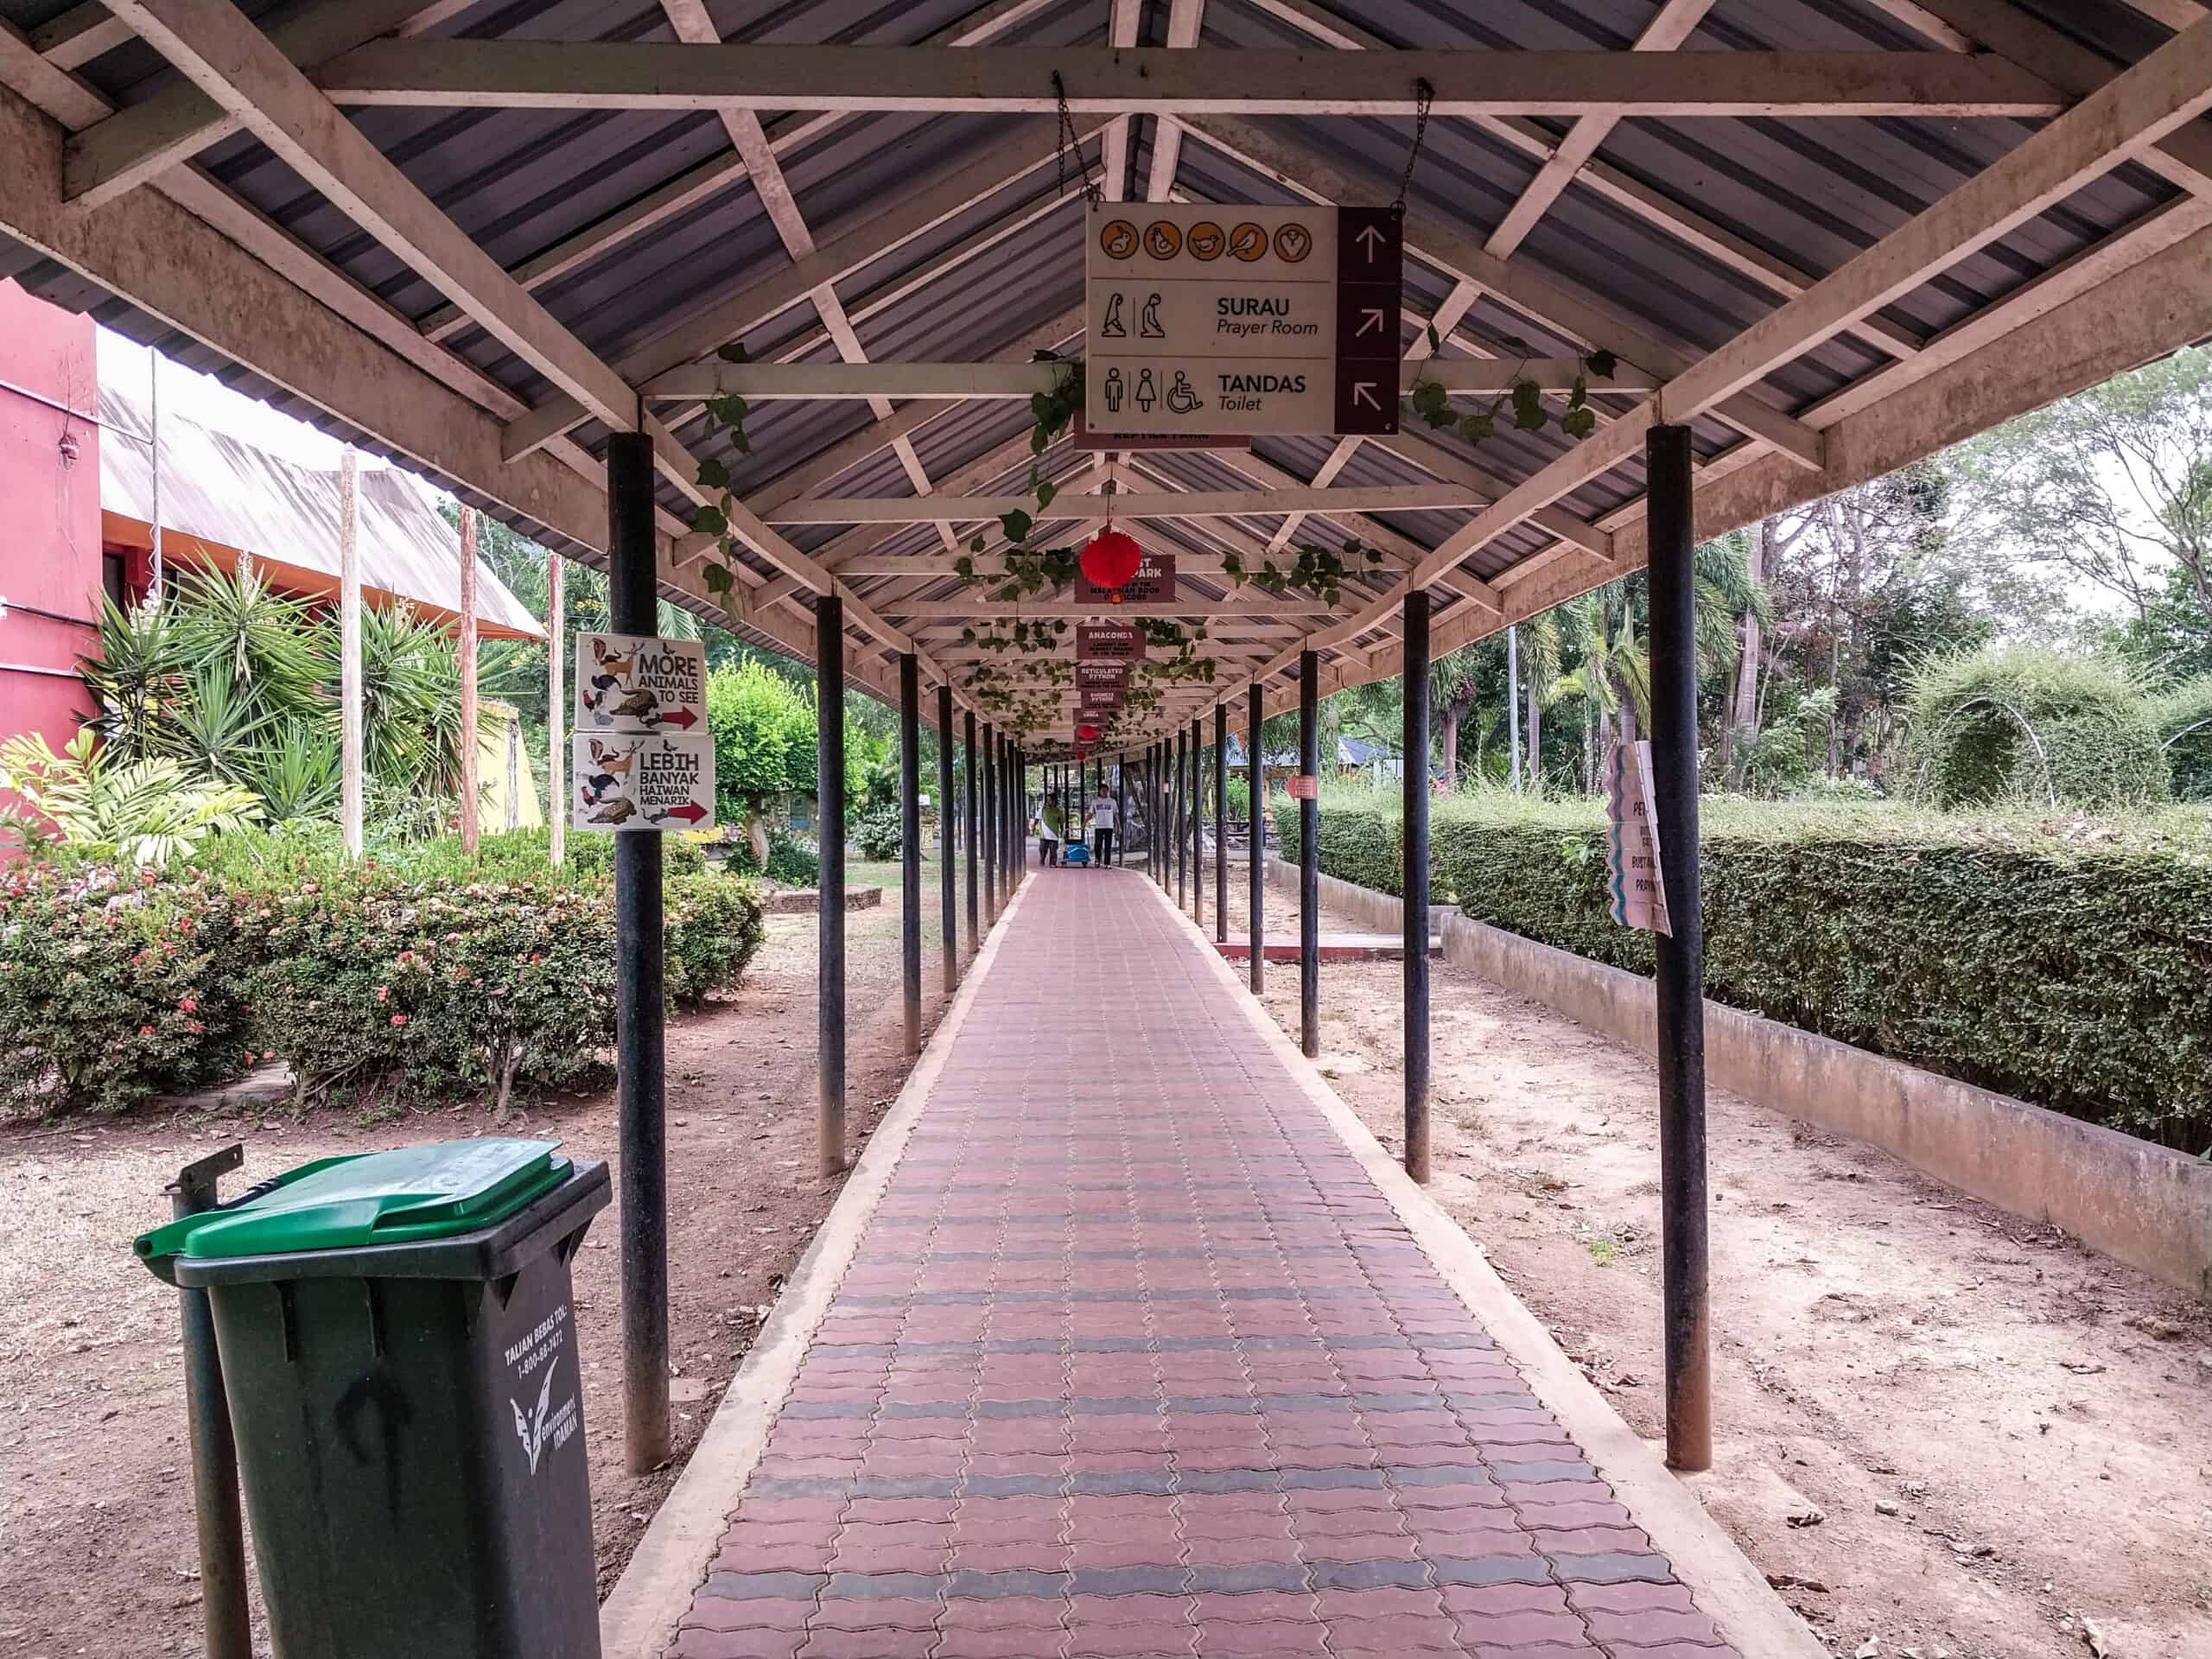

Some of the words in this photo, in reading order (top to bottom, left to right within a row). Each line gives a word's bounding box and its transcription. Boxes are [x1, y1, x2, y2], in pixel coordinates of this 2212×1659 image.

[1217, 296, 1290, 317] SURAU
[1217, 319, 1268, 338] Prayer
[1271, 319, 1319, 336] Room
[1218, 374, 1306, 394] TANDAS
[1218, 395, 1262, 412] Toilet
[638, 653, 698, 677] MORE
[638, 676, 699, 690] ANIMALS
[659, 690, 676, 703] TO
[679, 690, 699, 704] SEE
[639, 753, 699, 772] LEBIH
[639, 771, 699, 785] BANYAK
[639, 785, 690, 797] HAIWAN
[639, 796, 690, 805] MENARIK
[504, 1332, 533, 1367] TALIAN
[534, 1314, 556, 1344] BEBAS
[554, 1304, 568, 1325] TOL:
[553, 1410, 579, 1451] IDAMAN
